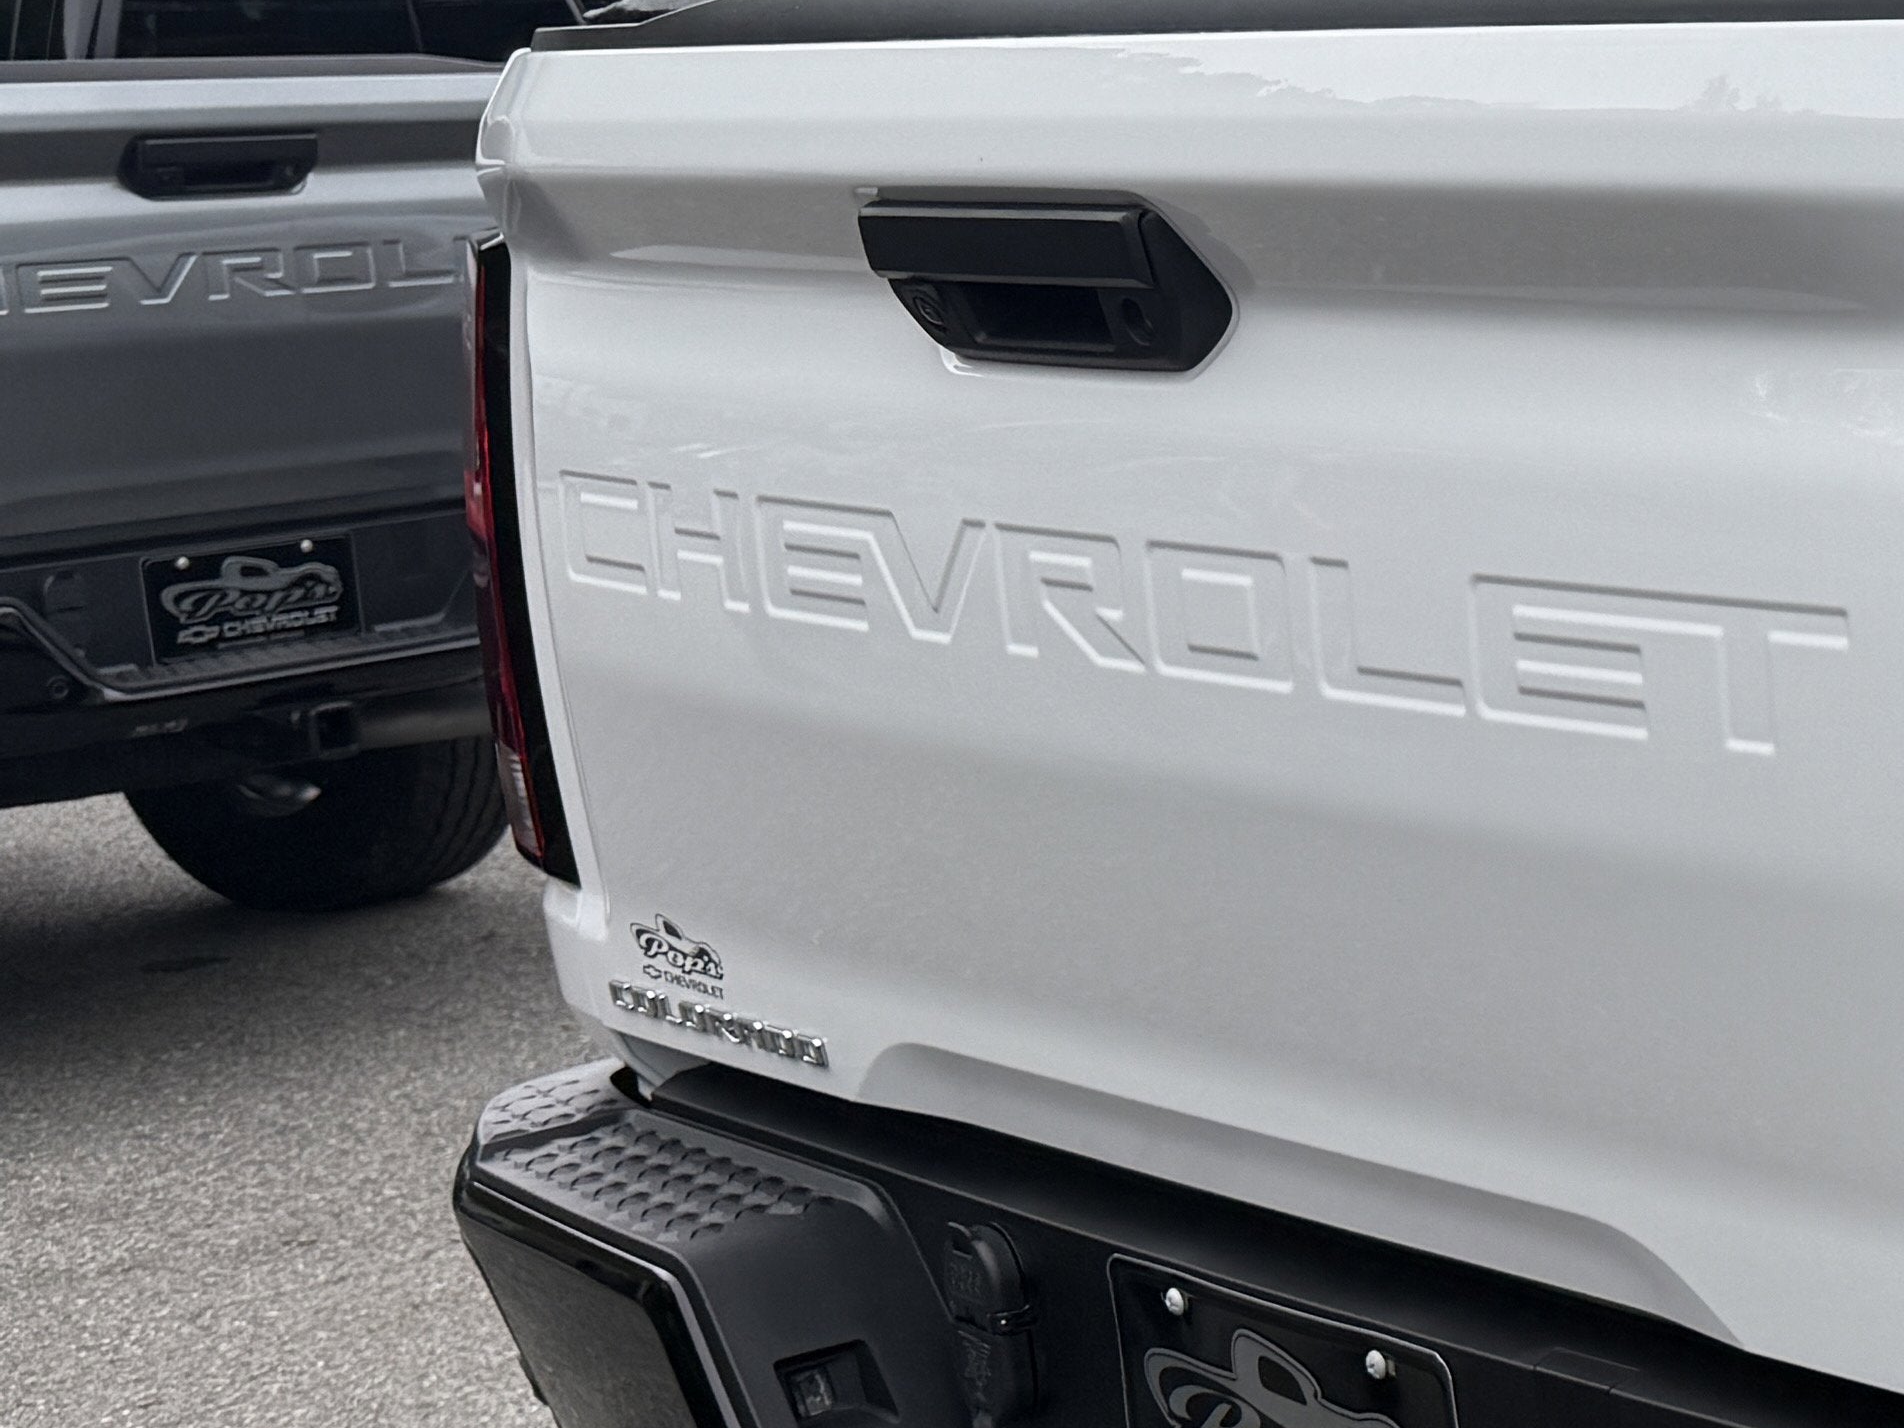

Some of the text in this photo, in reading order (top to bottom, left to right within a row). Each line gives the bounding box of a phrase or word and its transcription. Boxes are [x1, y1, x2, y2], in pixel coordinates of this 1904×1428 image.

[0, 240, 472, 318] EVROL
[222, 605, 340, 638] CHEVROLET
[561, 470, 1849, 756] CHEVROLET
[638, 932, 723, 980] Pop's
[664, 971, 724, 999] CHEVROLET
[608, 979, 829, 1067] COLORADO
